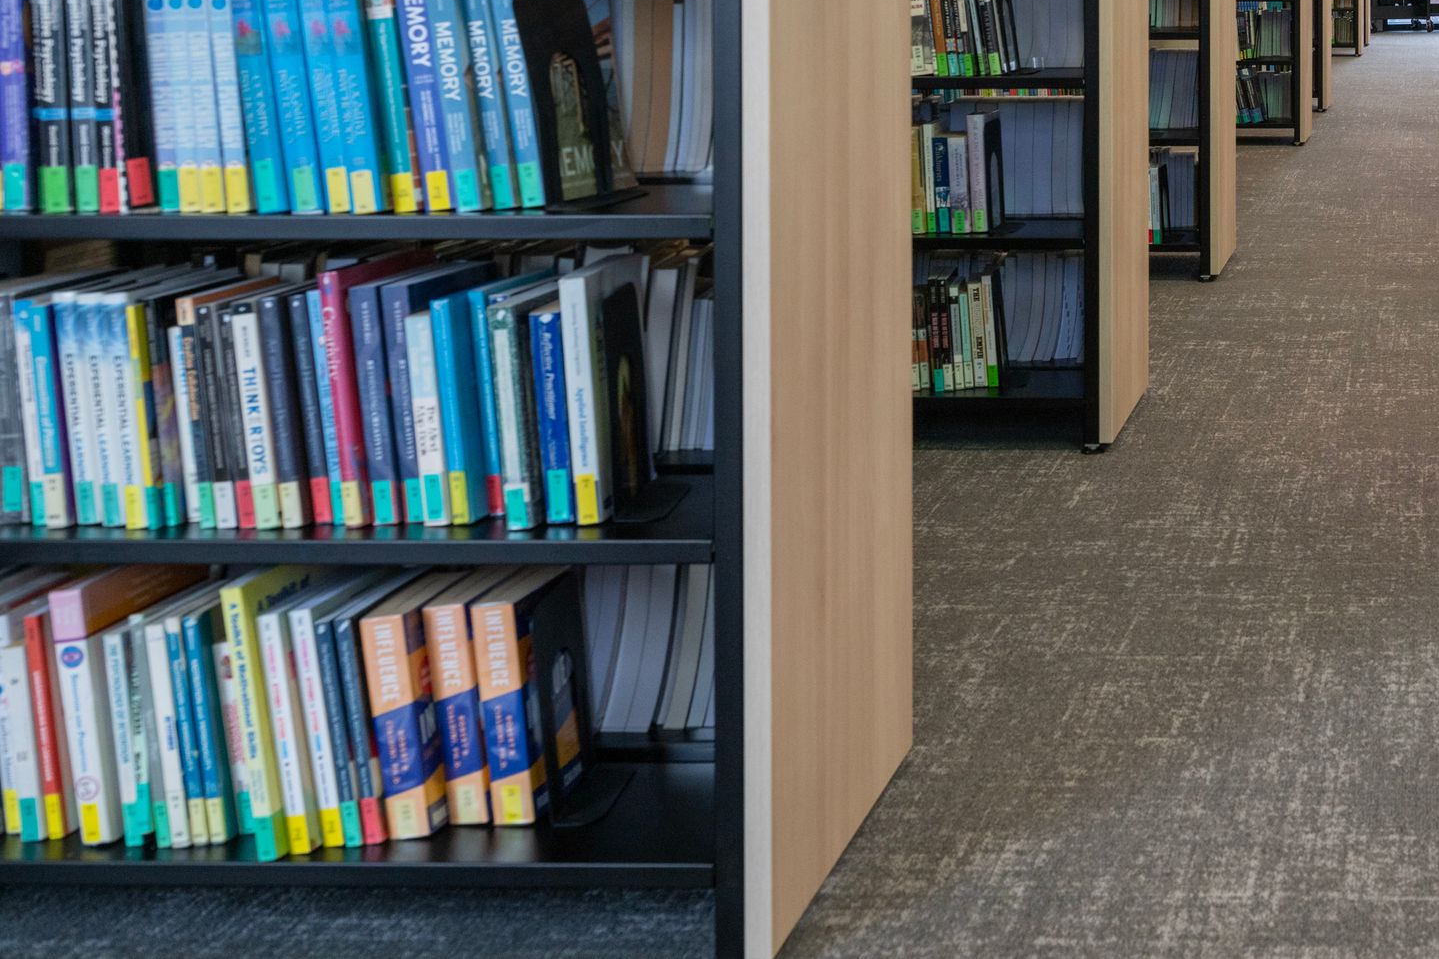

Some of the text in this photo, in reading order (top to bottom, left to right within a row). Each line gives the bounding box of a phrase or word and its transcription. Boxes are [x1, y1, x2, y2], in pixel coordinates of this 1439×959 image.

[40, 39, 60, 103] Psychology
[70, 39, 86, 103] Psychology
[93, 40, 114, 104] Psychology
[434, 21, 460, 101] MEMORY
[467, 20, 493, 100] MEMORY
[500, 19, 526, 97] MEMORY
[972, 288, 980, 302] THE
[64, 353, 86, 481] EXPERIENTIAL LEARNIN
[88, 355, 110, 484] EXPERIENTIAL LEARNIN
[113, 355, 134, 485] EXPERIENTIAL LEARNIN
[575, 388, 590, 468] Applied Intelligence
[374, 624, 398, 703] INFLUENCE
[436, 611, 455, 688] INFLUENCE
[485, 609, 508, 688] INFLUENCE
